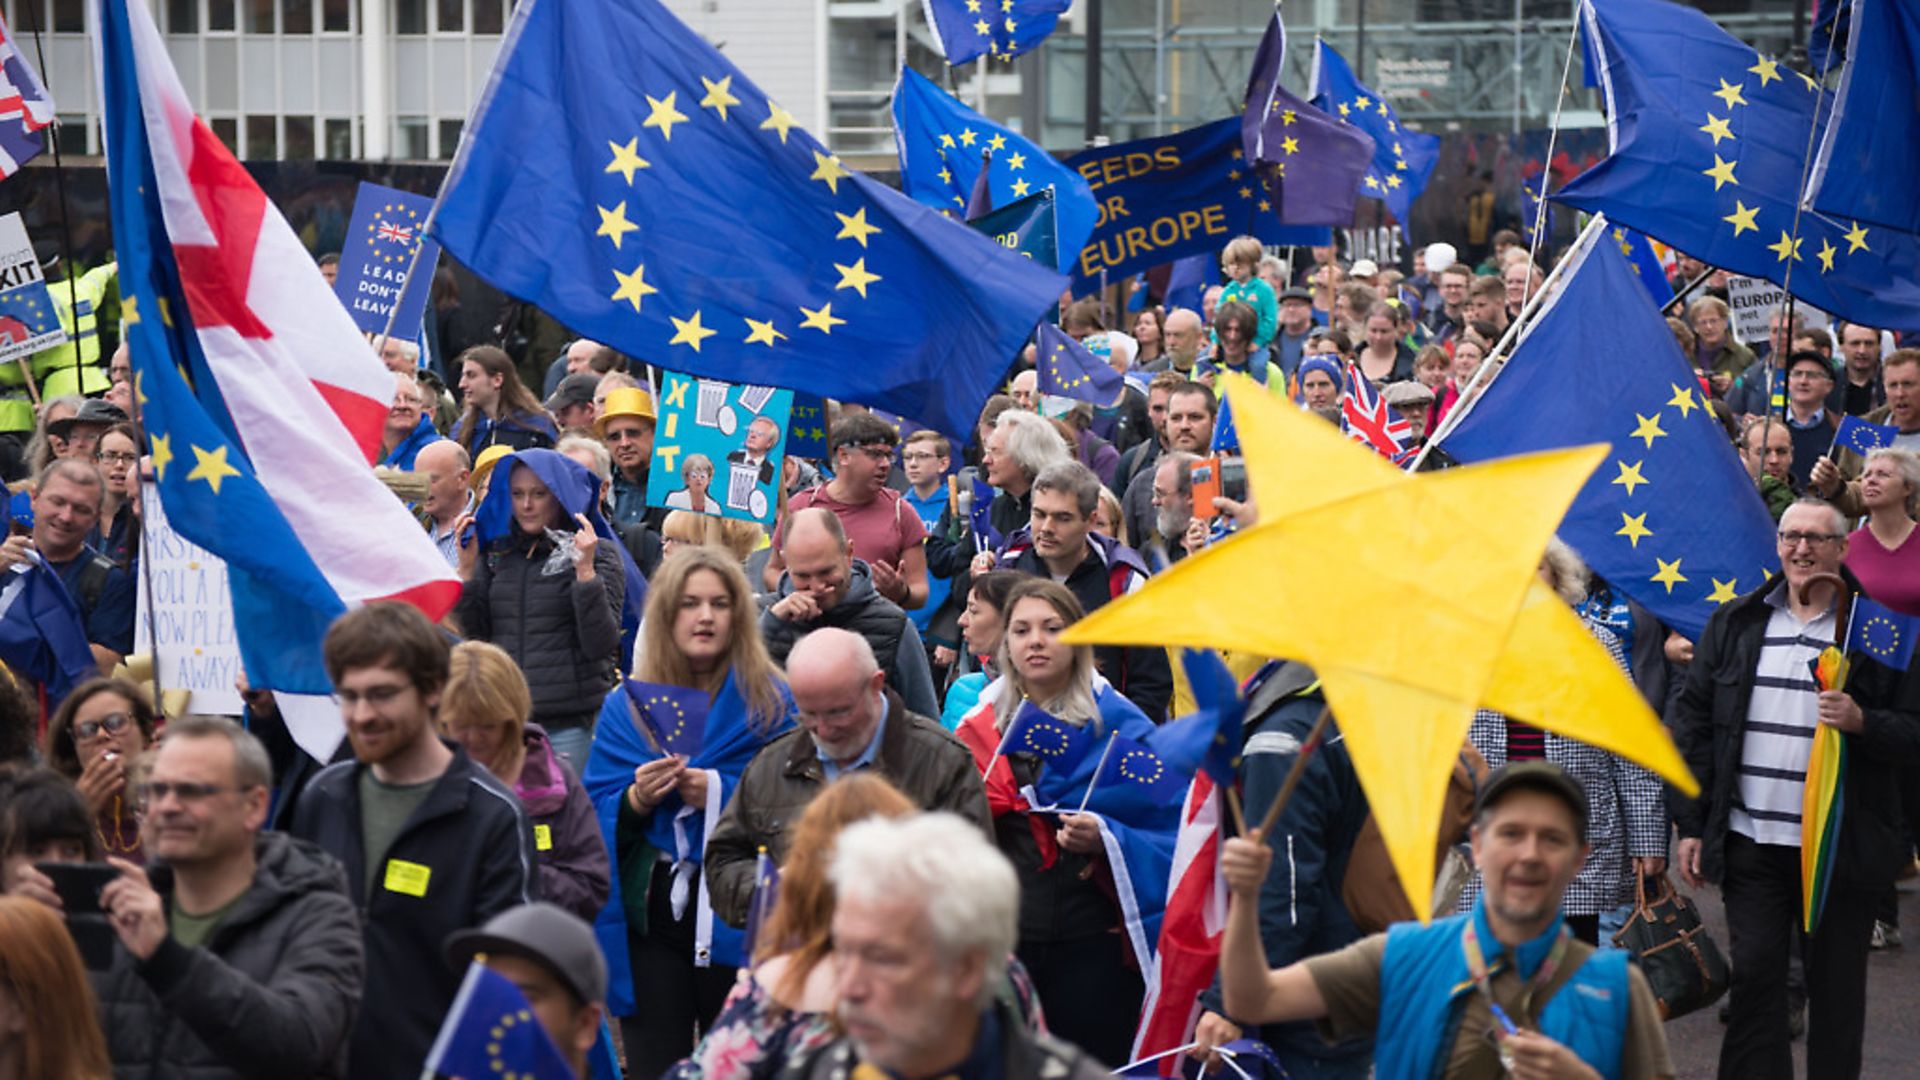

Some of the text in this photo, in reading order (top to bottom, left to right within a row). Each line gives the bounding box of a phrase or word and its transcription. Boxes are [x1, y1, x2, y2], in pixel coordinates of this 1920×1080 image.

[1080, 204, 1228, 277] EUROPE
[363, 263, 406, 283] LEAD
[358, 280, 402, 301] DON'T
